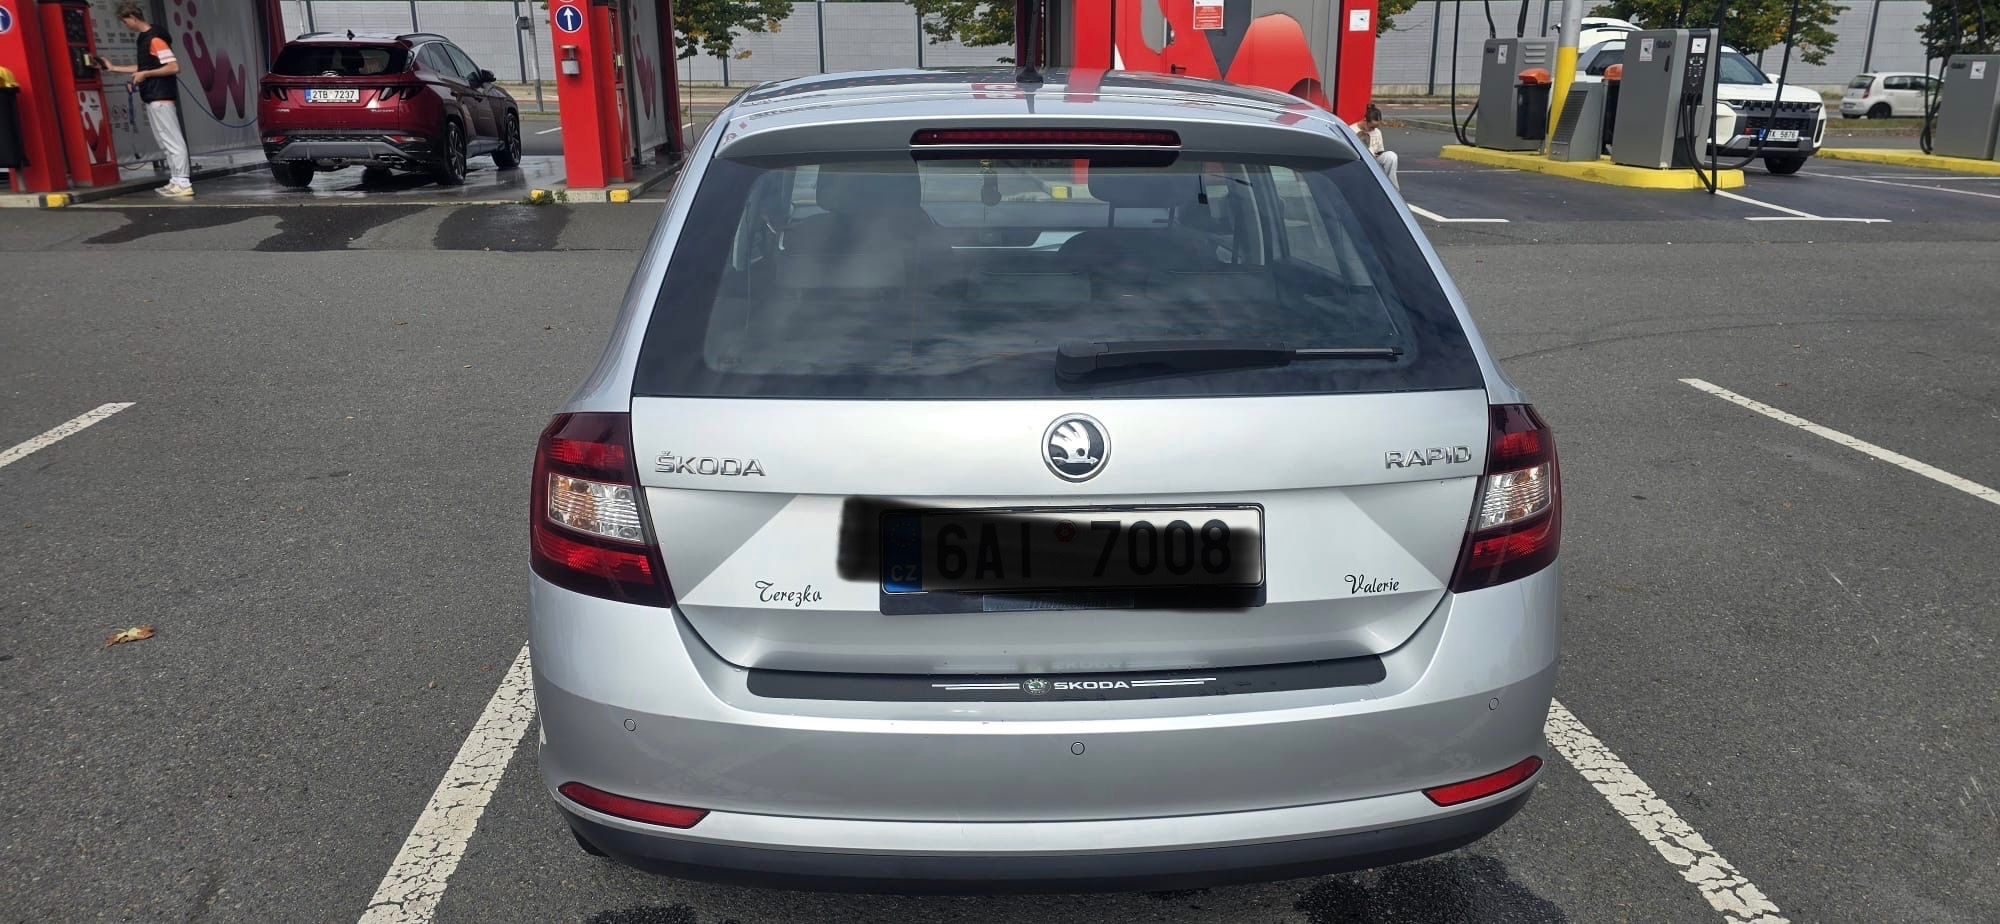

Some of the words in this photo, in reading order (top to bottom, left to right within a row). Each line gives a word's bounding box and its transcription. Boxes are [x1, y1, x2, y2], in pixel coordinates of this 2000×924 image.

[312, 90, 328, 99] 2TB
[334, 90, 355, 99] 7237
[655, 450, 766, 477] ŠKODA
[1384, 444, 1472, 469] RAPID
[1089, 518, 1232, 578] 7008
[890, 564, 918, 583] CZ
[1344, 574, 1400, 595] Valerie
[754, 580, 823, 608] Terezka
[1053, 680, 1130, 690] SKODA
